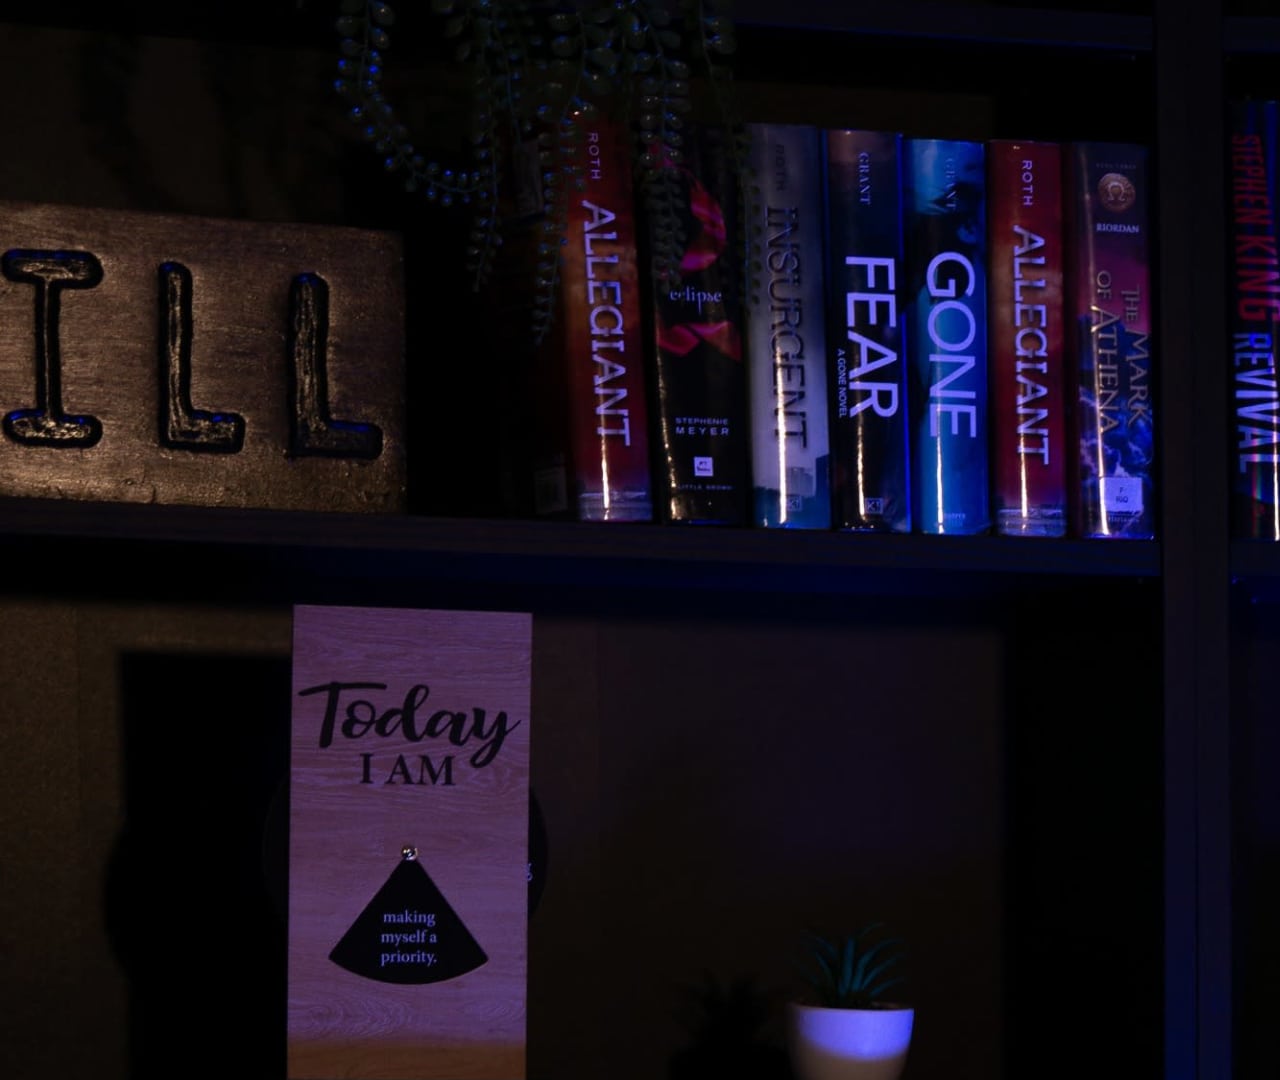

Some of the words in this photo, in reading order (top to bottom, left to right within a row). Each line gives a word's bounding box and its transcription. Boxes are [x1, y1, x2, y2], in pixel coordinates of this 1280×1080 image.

[588, 131, 601, 181] ROTH
[857, 151, 872, 207] GRANT
[1232, 133, 1273, 226] STEPHEN
[944, 157, 958, 212] GRANT
[1020, 159, 1034, 207] ROTH
[1096, 222, 1140, 233] RIORDAN
[669, 285, 722, 315] eclipse
[1096, 270, 1113, 301] OF
[1120, 286, 1140, 323] THE
[580, 200, 632, 447] ALLEGIANT
[764, 206, 809, 448] INSURGENT
[844, 255, 899, 419] FEAR
[926, 250, 977, 439] GONE
[1012, 225, 1050, 465] ALLEGIANT
[837, 358, 846, 386] GONE
[1090, 305, 1119, 434] ATHENA
[1125, 329, 1151, 428] MARK
[837, 387, 847, 419] NOVEL
[675, 427, 730, 436] MEYER
[299, 681, 521, 769] Today
[360, 753, 374, 784] I
[386, 754, 455, 785] AM
[381, 929, 425, 947] myself
[429, 934, 437, 943] a
[383, 910, 436, 929] making
[381, 949, 437, 967] priority.
